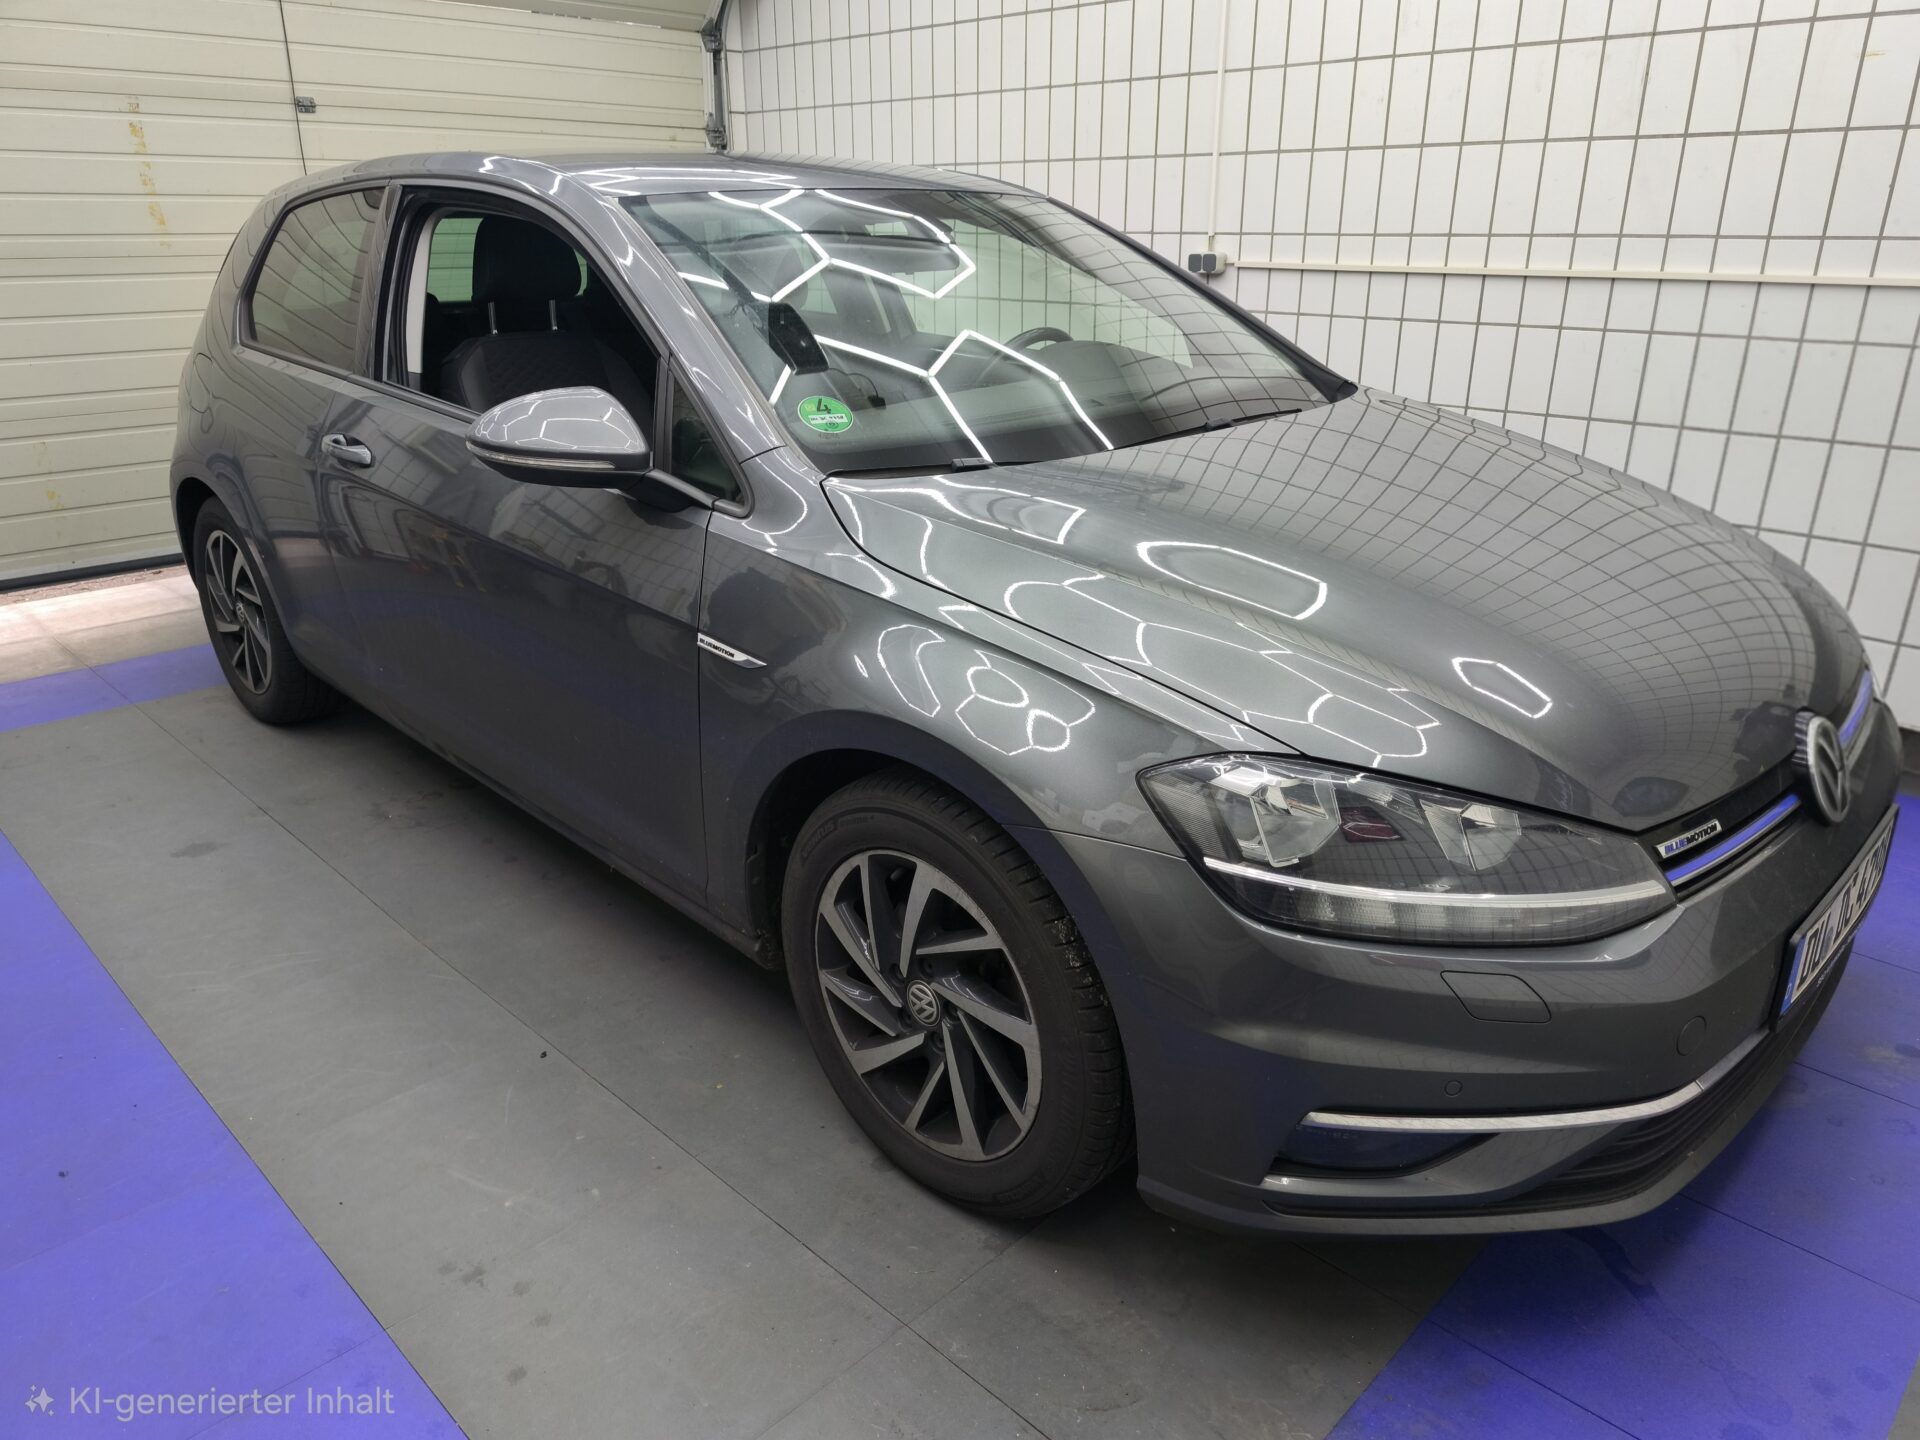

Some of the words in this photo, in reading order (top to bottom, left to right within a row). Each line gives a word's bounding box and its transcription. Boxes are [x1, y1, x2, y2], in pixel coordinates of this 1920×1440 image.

[817, 398, 831, 414] 4
[700, 637, 735, 658] BLUEMOTION
[1664, 822, 1718, 855] BLUEMOTION
